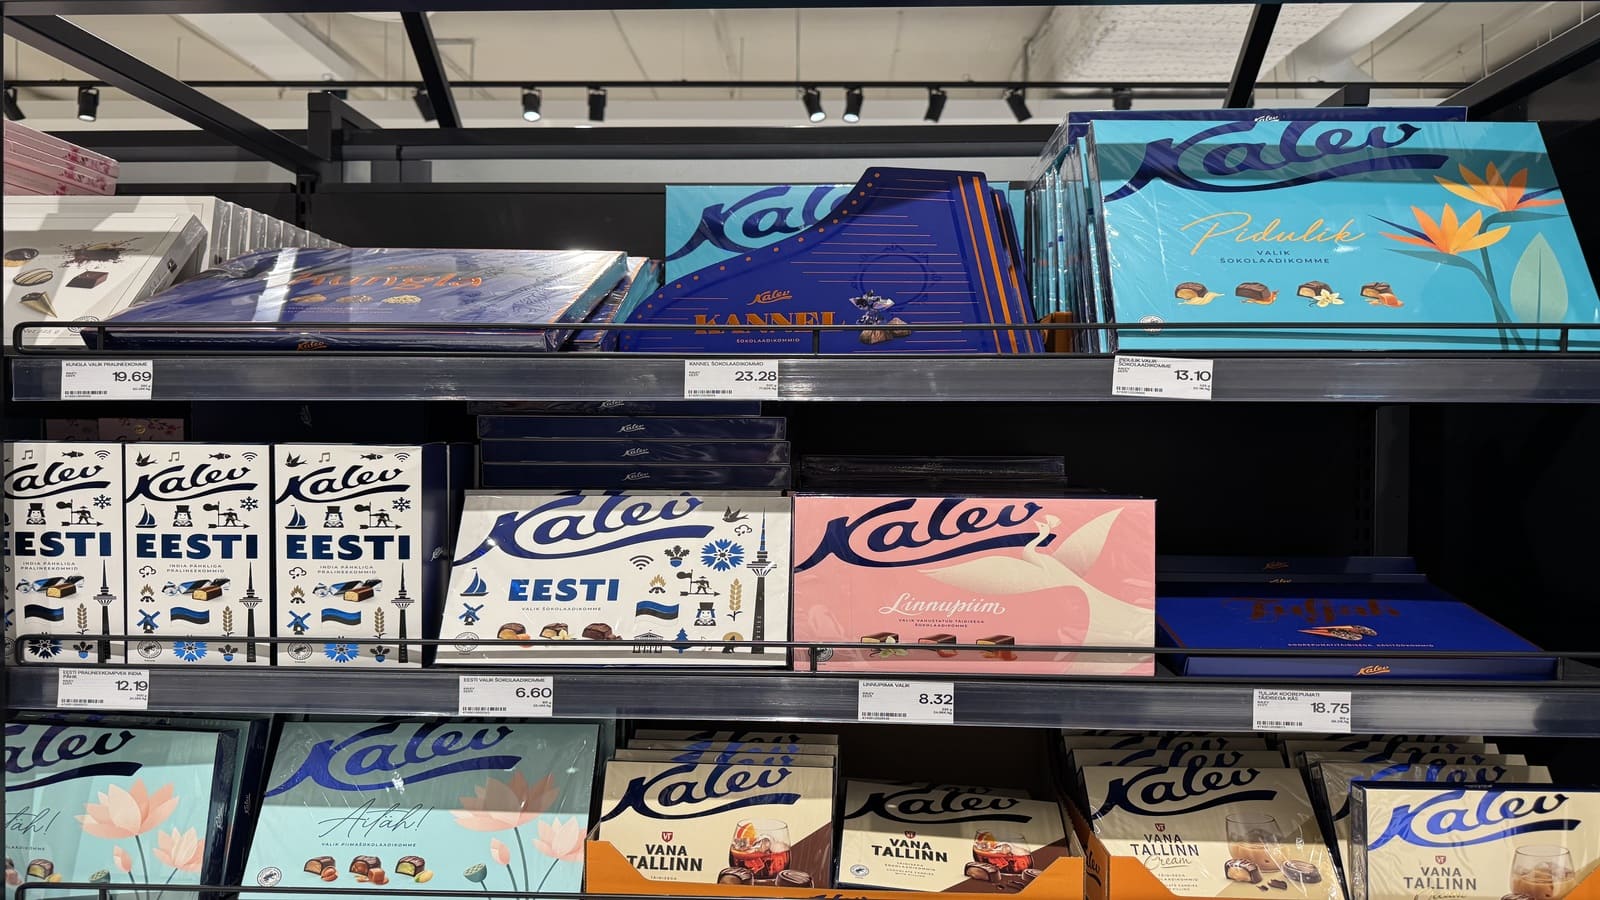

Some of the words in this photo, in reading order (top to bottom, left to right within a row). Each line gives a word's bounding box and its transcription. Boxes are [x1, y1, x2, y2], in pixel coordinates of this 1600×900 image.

[1102, 121, 1448, 202] Kalev
[666, 186, 850, 262] Kal
[1180, 211, 1366, 257] Pidulik
[746, 290, 793, 306] Kalev
[693, 311, 846, 334] KANNEL
[112, 371, 152, 382] 19.69
[735, 370, 777, 382] 23.28
[1174, 369, 1212, 382] 13.10
[616, 423, 647, 433] Kalev
[622, 447, 651, 457] Kalev
[126, 463, 259, 504] Kalev
[274, 465, 411, 504] Kalev
[623, 471, 652, 481] Kalev
[452, 492, 715, 568] Kalev
[793, 499, 1058, 574] Kalev
[136, 533, 258, 560] EESTI
[286, 534, 411, 561] EESTI
[508, 578, 620, 602] EESTI
[878, 592, 1006, 618] Linnupiim
[1356, 665, 1391, 676] Kalev
[115, 680, 148, 692] 12.19
[515, 687, 552, 699] 6.60
[918, 693, 953, 705] 8.32
[1310, 702, 1350, 714] 18.75
[263, 723, 523, 797] Kalev
[600, 764, 802, 823] Kalev
[1091, 766, 1278, 820] Kalev
[843, 788, 1033, 825] Kalev
[5, 805, 61, 836] täh!
[318, 797, 435, 838] Aitäh!
[1367, 791, 1582, 850] Kalev
[889, 838, 932, 850] VANA
[1143, 834, 1183, 844] VANA
[645, 844, 688, 857] VANA
[871, 845, 948, 863] TALLINN
[1130, 844, 1200, 857] TALLINN
[626, 855, 703, 872] TALLINN
[1143, 855, 1193, 871] Cream
[1420, 867, 1463, 877] VANA
[1403, 876, 1478, 891] TALLINN
